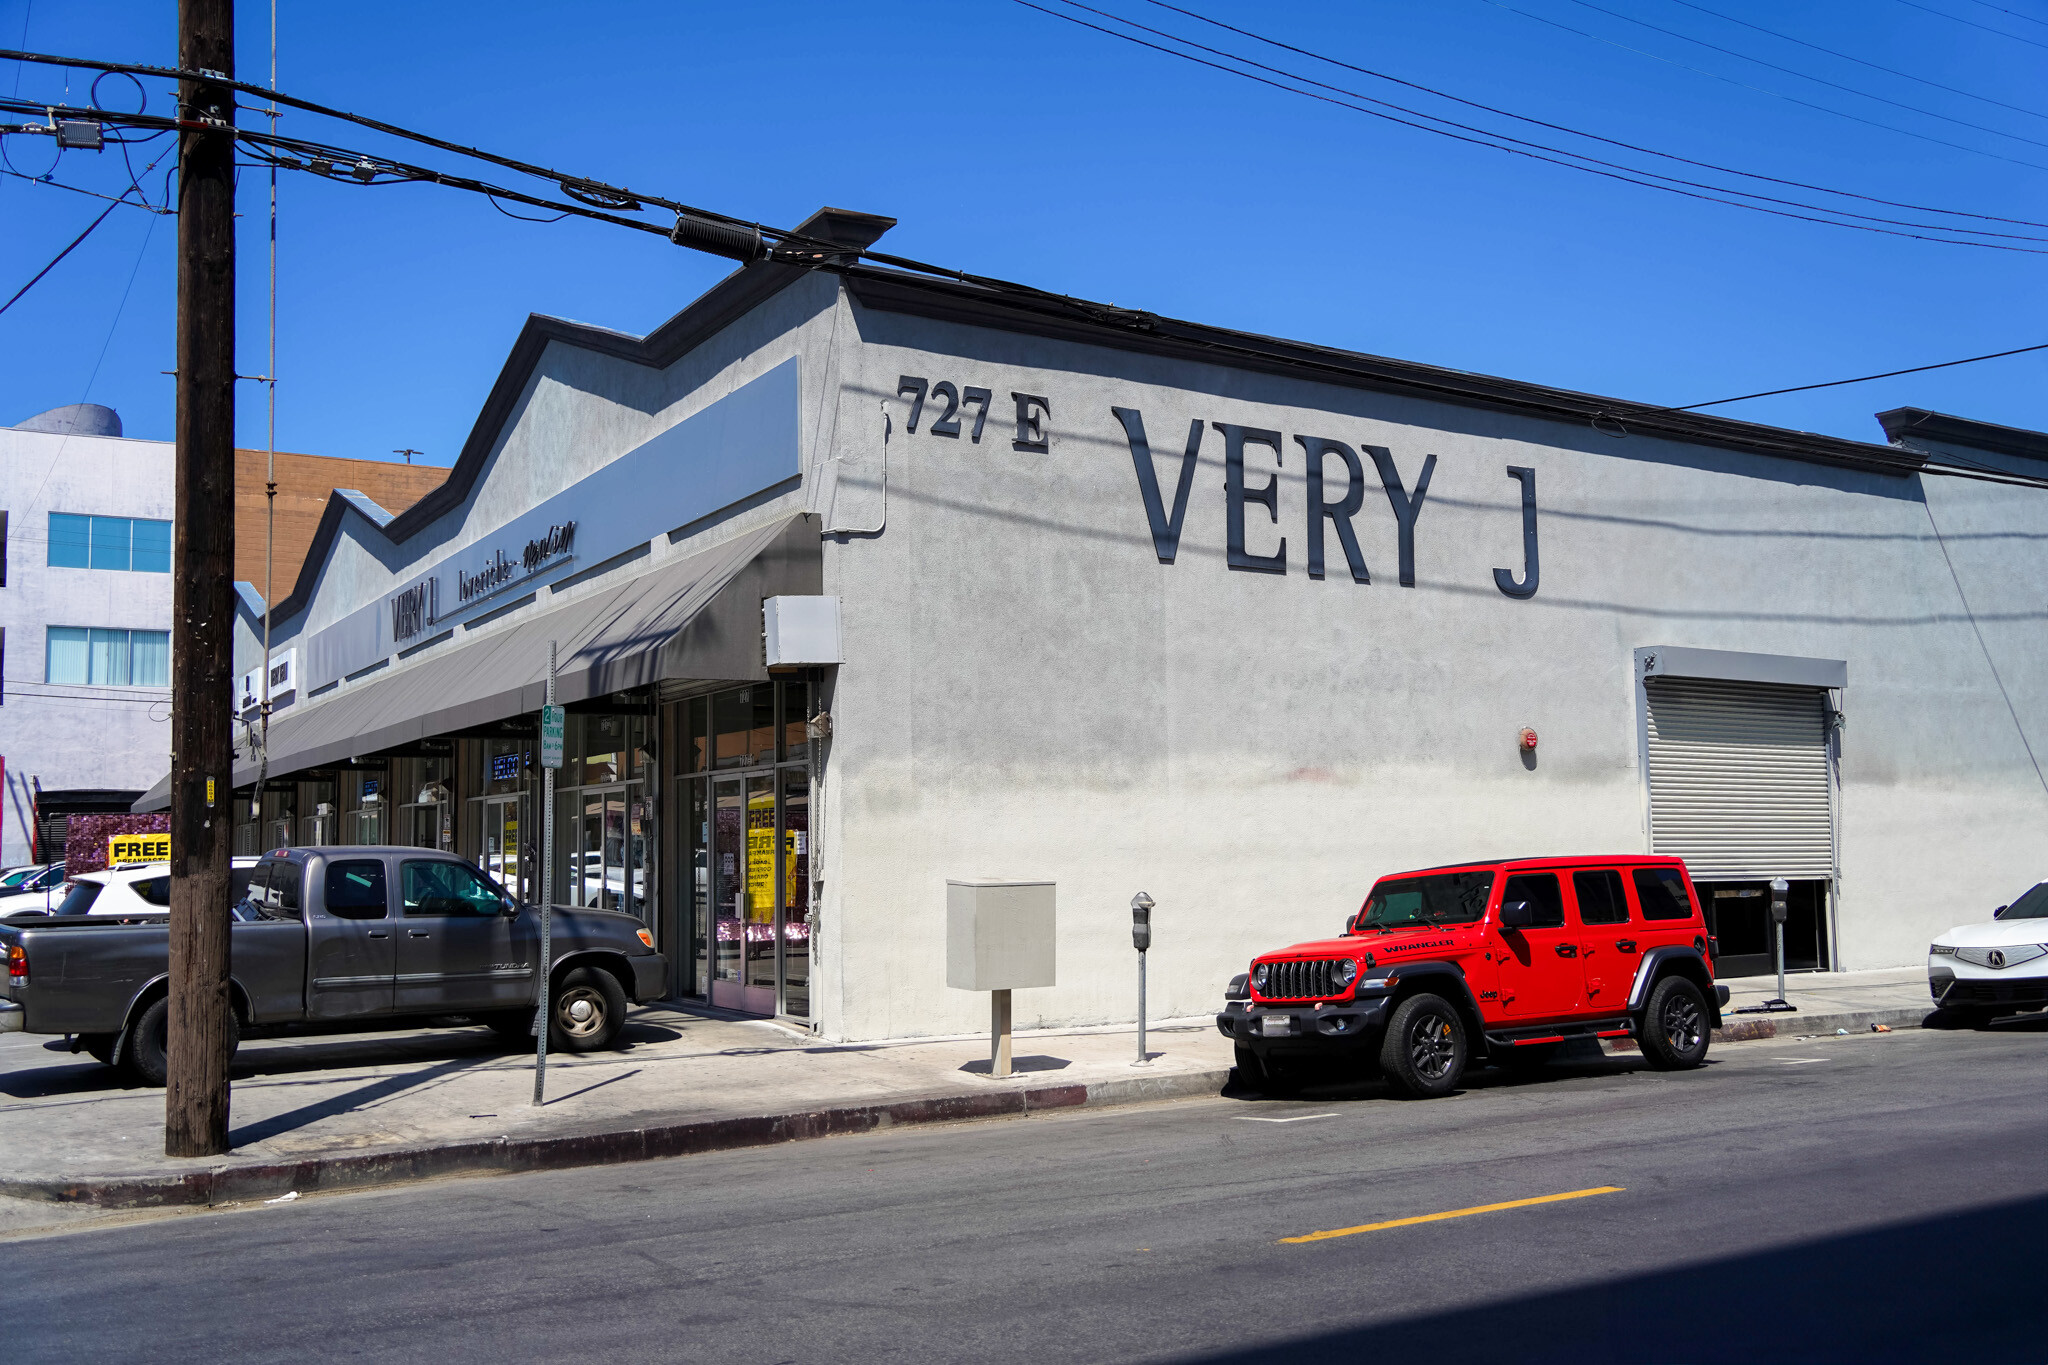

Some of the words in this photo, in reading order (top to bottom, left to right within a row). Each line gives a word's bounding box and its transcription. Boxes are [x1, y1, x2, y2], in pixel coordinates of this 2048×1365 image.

[898, 375, 993, 443] 727
[1010, 391, 1052, 453] E
[1110, 405, 1438, 588] VERY
[1492, 464, 1540, 598] J
[391, 582, 426, 642] VERY
[426, 576, 436, 627] J
[544, 708, 550, 722] 2
[543, 725, 563, 739] PARKING
[748, 807, 775, 829] FREE
[113, 842, 168, 857] FREE
[1384, 940, 1455, 953] WRANGLER
[494, 962, 530, 970] TUNDRA
[1480, 990, 1498, 999] Jeep
